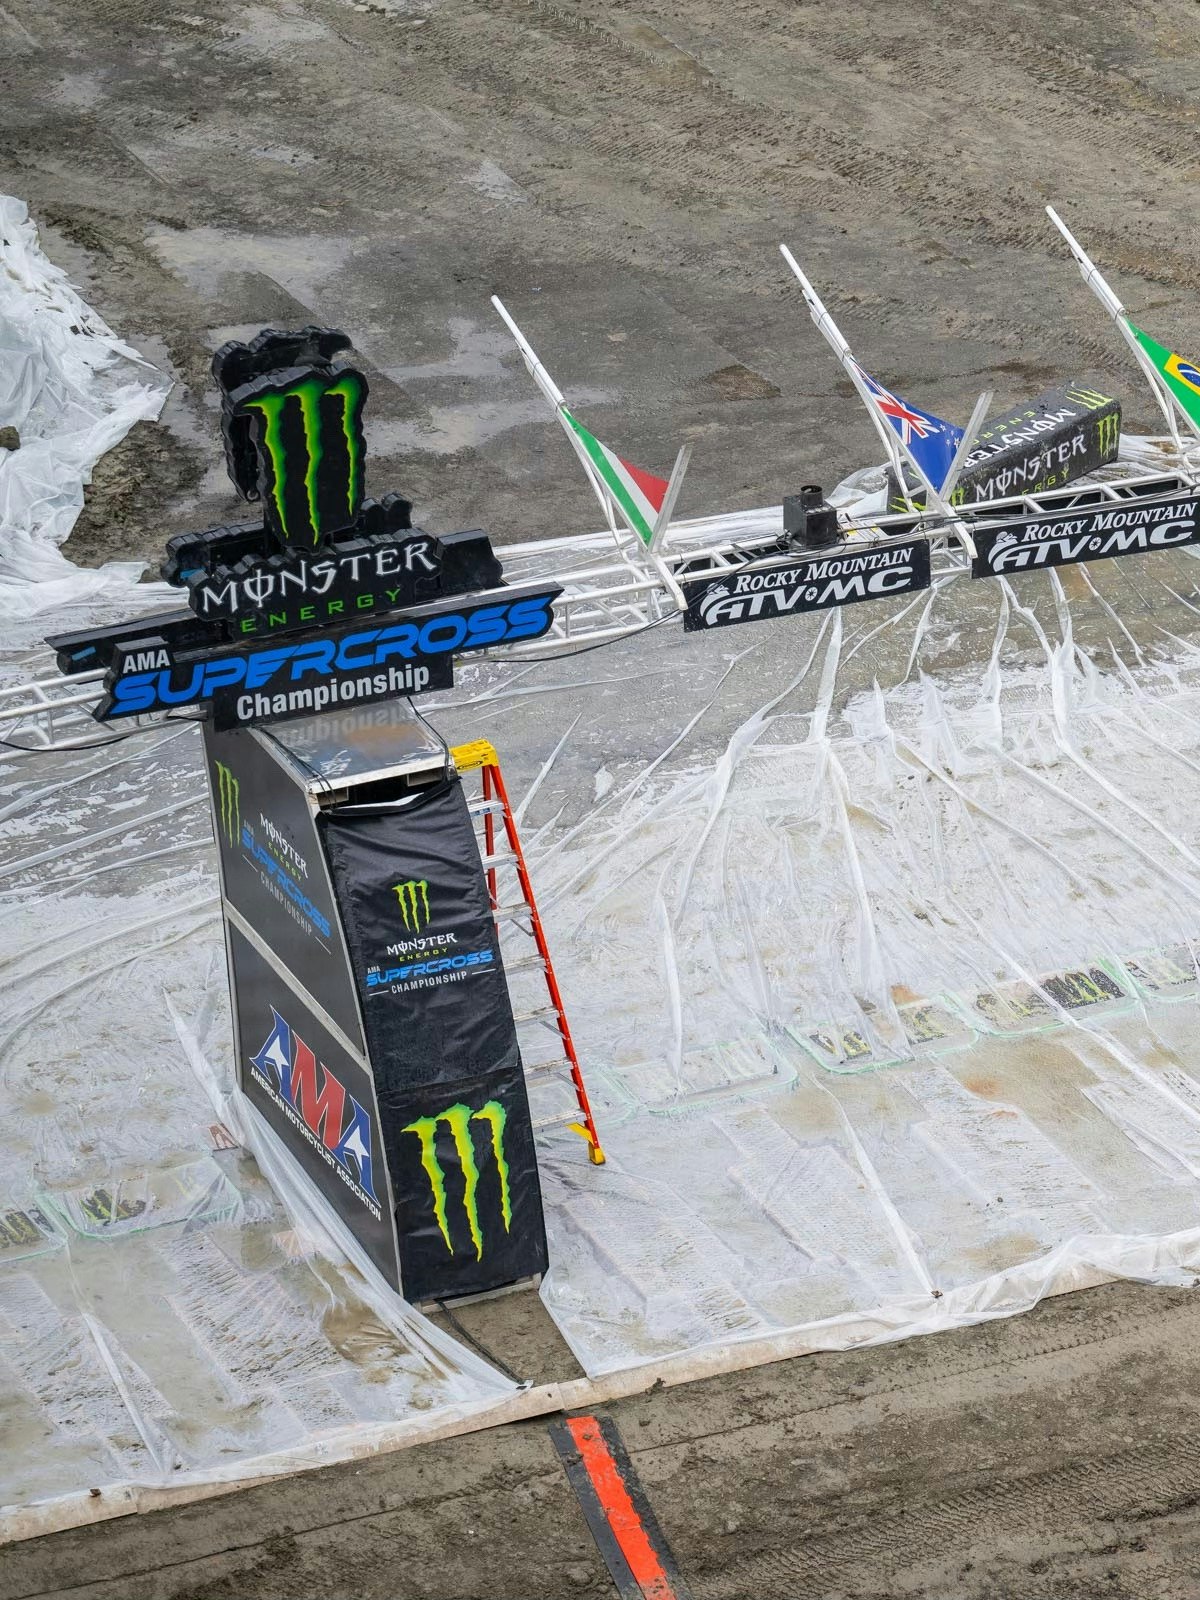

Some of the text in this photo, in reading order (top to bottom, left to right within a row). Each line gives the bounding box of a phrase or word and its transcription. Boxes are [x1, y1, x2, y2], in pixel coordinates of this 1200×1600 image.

[1021, 502, 1198, 543] ROCKY MOUNTAIN
[202, 540, 438, 615] MONSTER
[734, 547, 913, 594] ROCKY MOUNTAIN
[240, 588, 402, 634] ENERGY
[109, 596, 553, 715] SUPERCROSS
[122, 649, 170, 674] AMA
[237, 663, 430, 720] Championship
[260, 871, 312, 936] CHAMPIONSHIP
[366, 949, 494, 987] SUPERCROSS
[367, 965, 381, 974] AMA
[399, 947, 448, 962] ENERGY
[391, 971, 467, 994] CHAMPIONSHIP
[249, 1004, 381, 1208] AMA
[250, 1066, 381, 1222] AMERICAN MOTORCYCLIST ASSOCIATION
